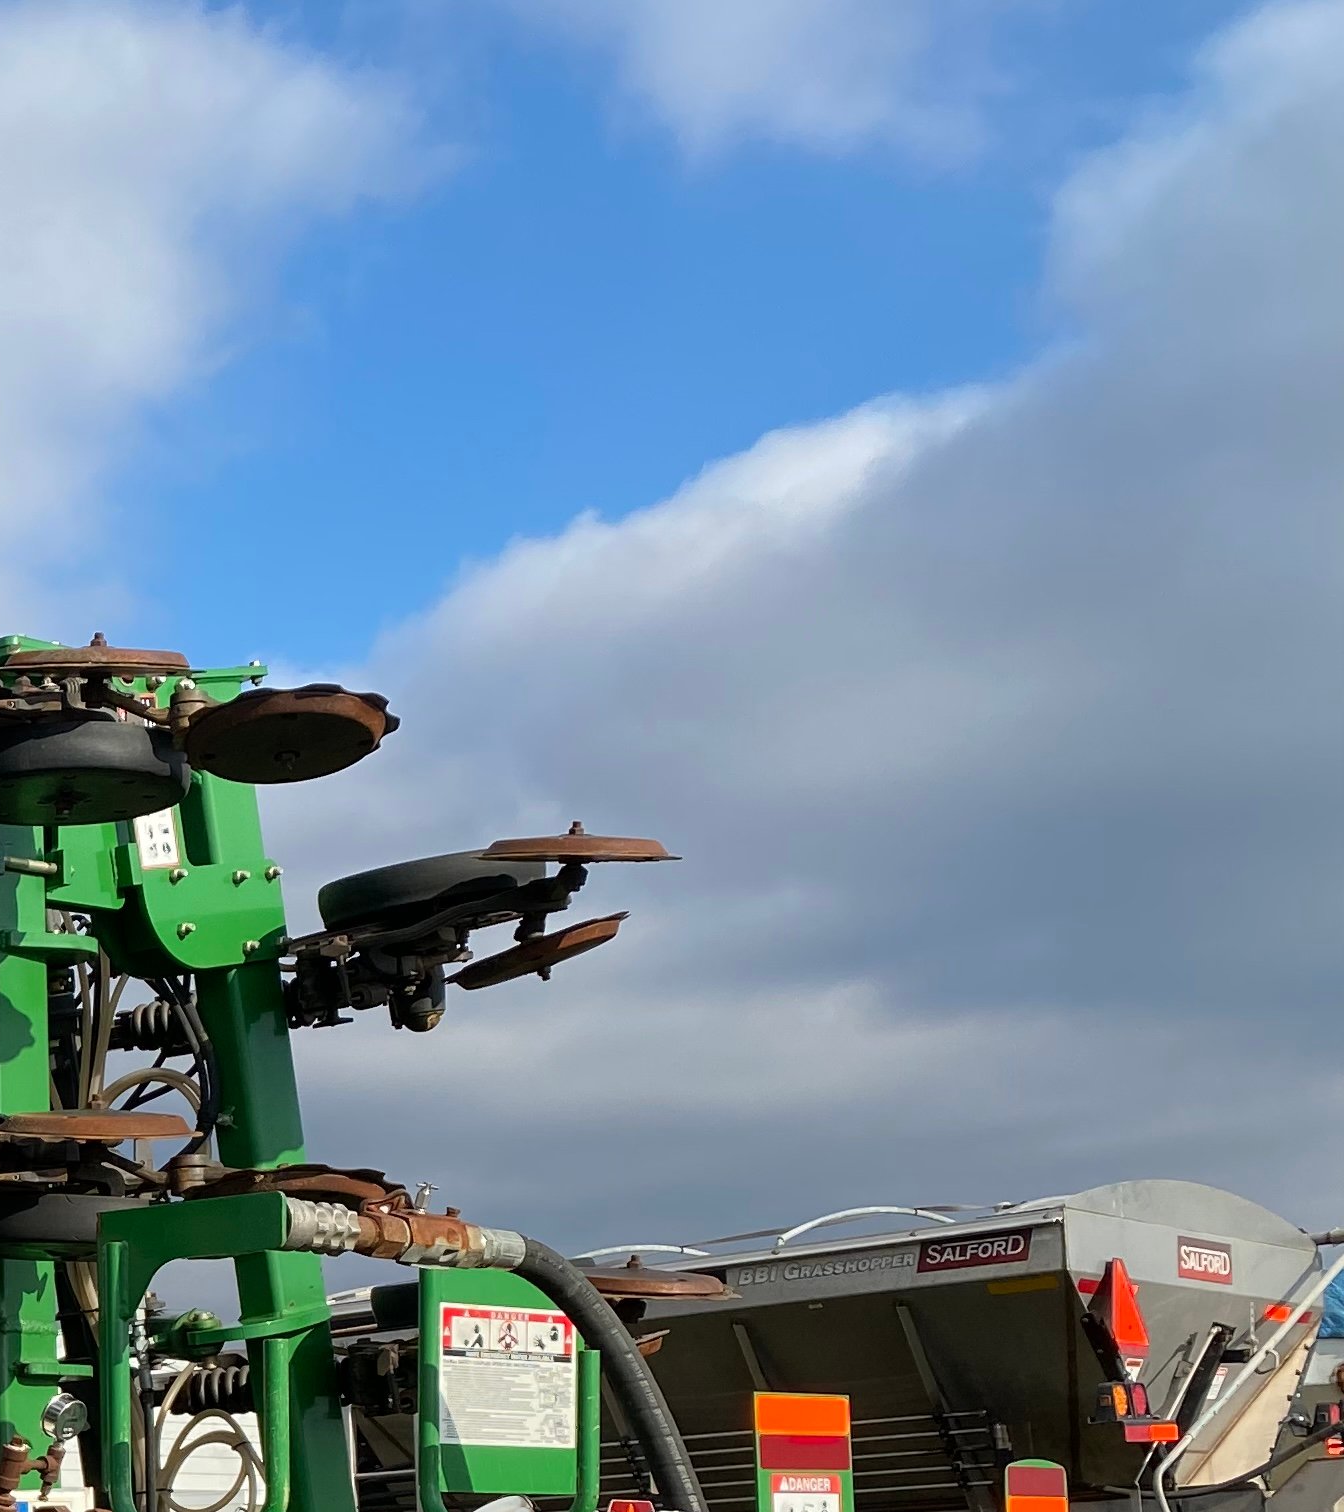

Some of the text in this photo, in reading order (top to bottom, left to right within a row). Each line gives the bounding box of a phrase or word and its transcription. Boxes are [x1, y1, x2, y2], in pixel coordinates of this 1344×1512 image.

[738, 1235, 1025, 1286] BBI GRASSHOPPER SALFORD
[1180, 1245, 1231, 1275] SALFORD
[788, 1477, 832, 1492] DANGER
